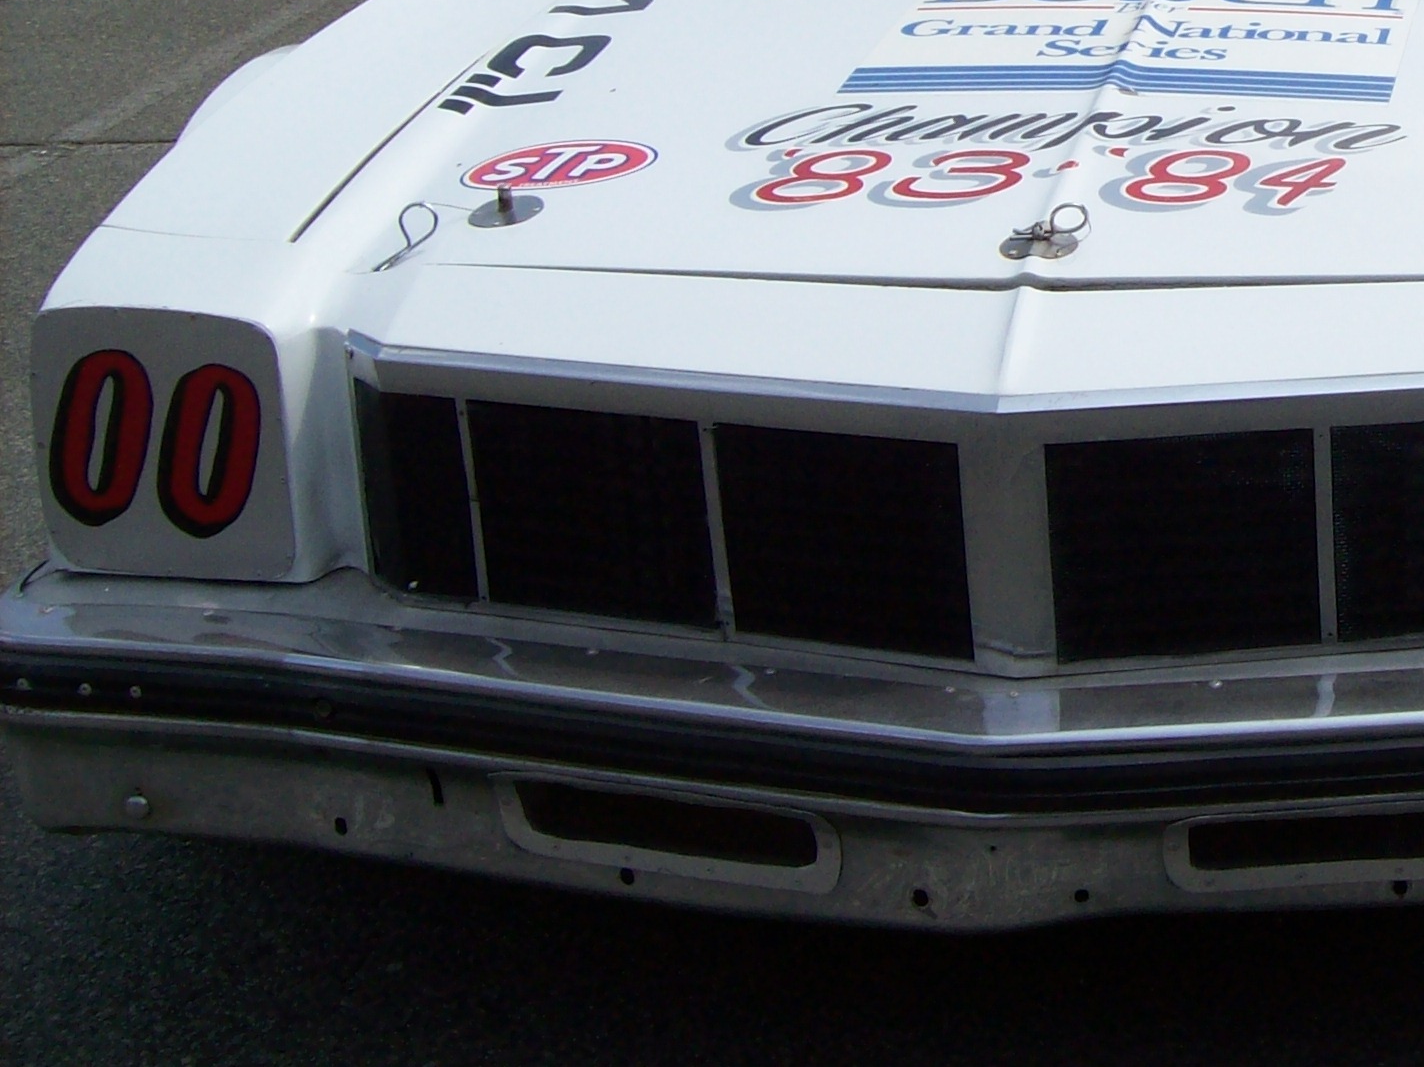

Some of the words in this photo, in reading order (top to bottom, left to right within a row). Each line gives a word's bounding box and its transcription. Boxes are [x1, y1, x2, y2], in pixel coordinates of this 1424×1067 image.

[900, 18, 1102, 38] Grand
[1130, 14, 1392, 46] National
[1036, 38, 1228, 62] Series
[746, 104, 1408, 150] Champion
[480, 145, 628, 182] STP
[50, 348, 261, 540] 00
